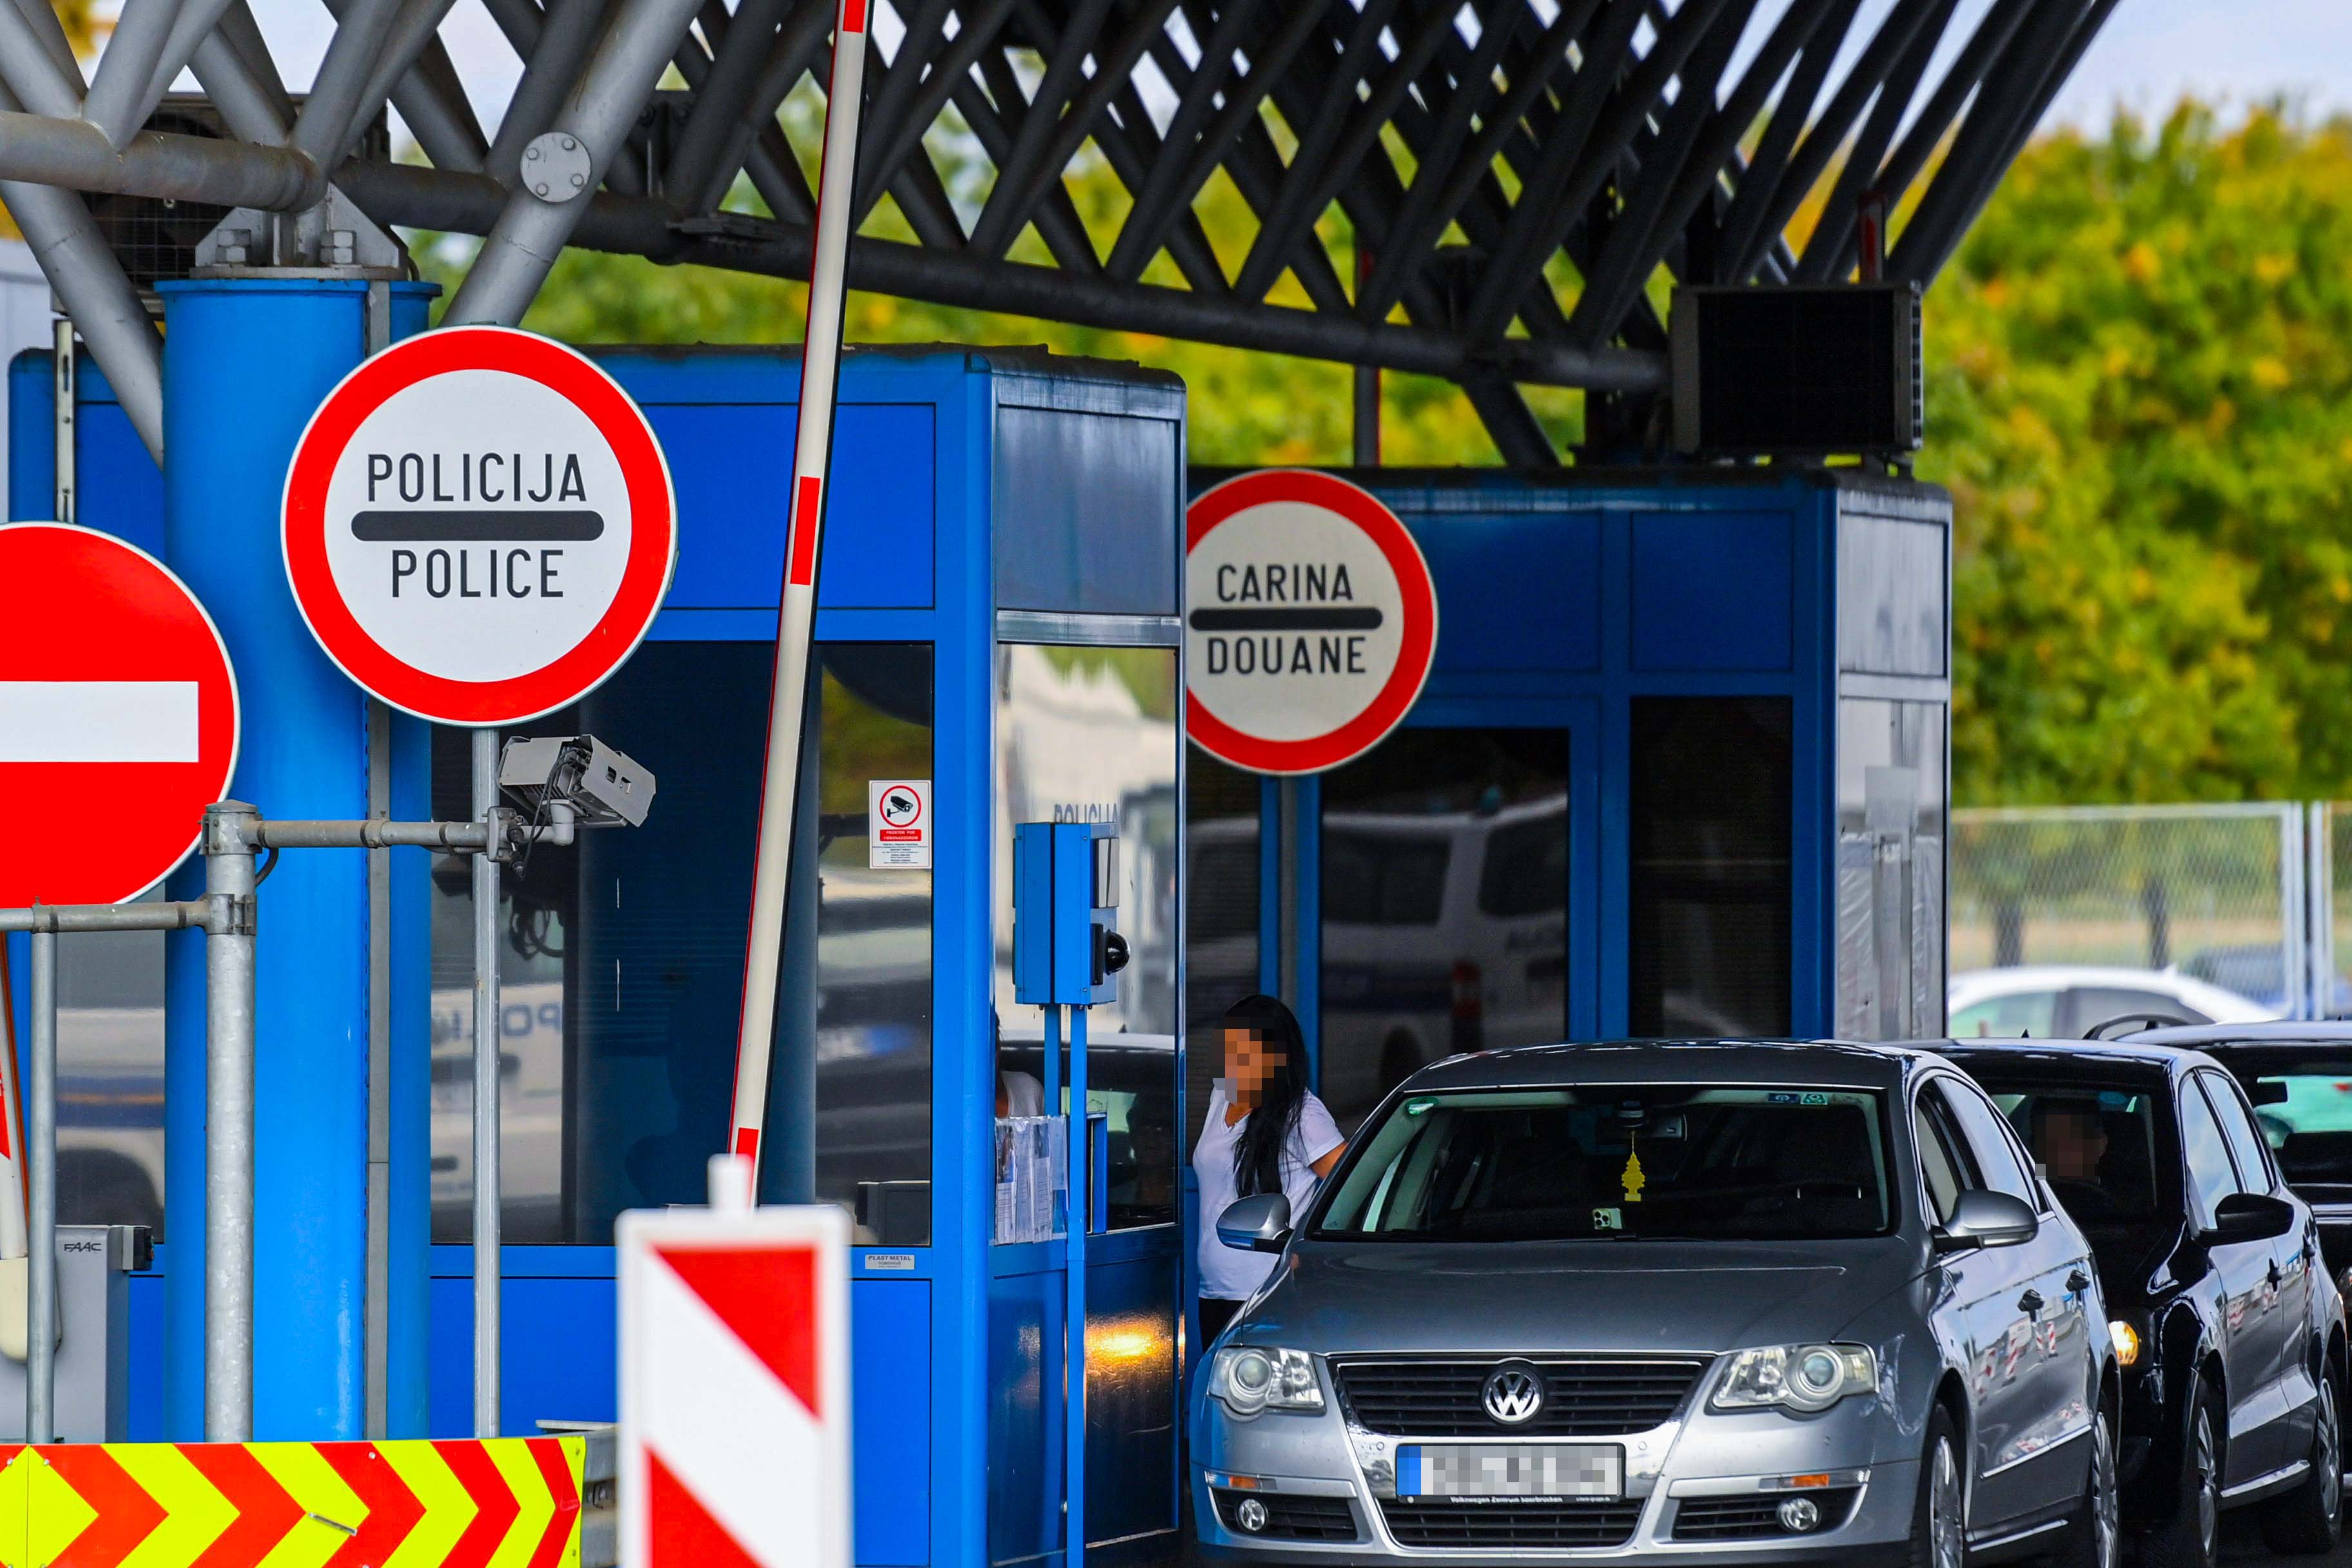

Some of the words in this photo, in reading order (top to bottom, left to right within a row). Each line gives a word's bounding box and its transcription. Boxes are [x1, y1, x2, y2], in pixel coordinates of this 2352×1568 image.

[368, 452, 587, 503] POLICIJA
[391, 548, 564, 598] POLICE
[1217, 563, 1354, 603] CARINA
[1207, 635, 1367, 675] DOUANE
[63, 1242, 102, 1253] FAAC
